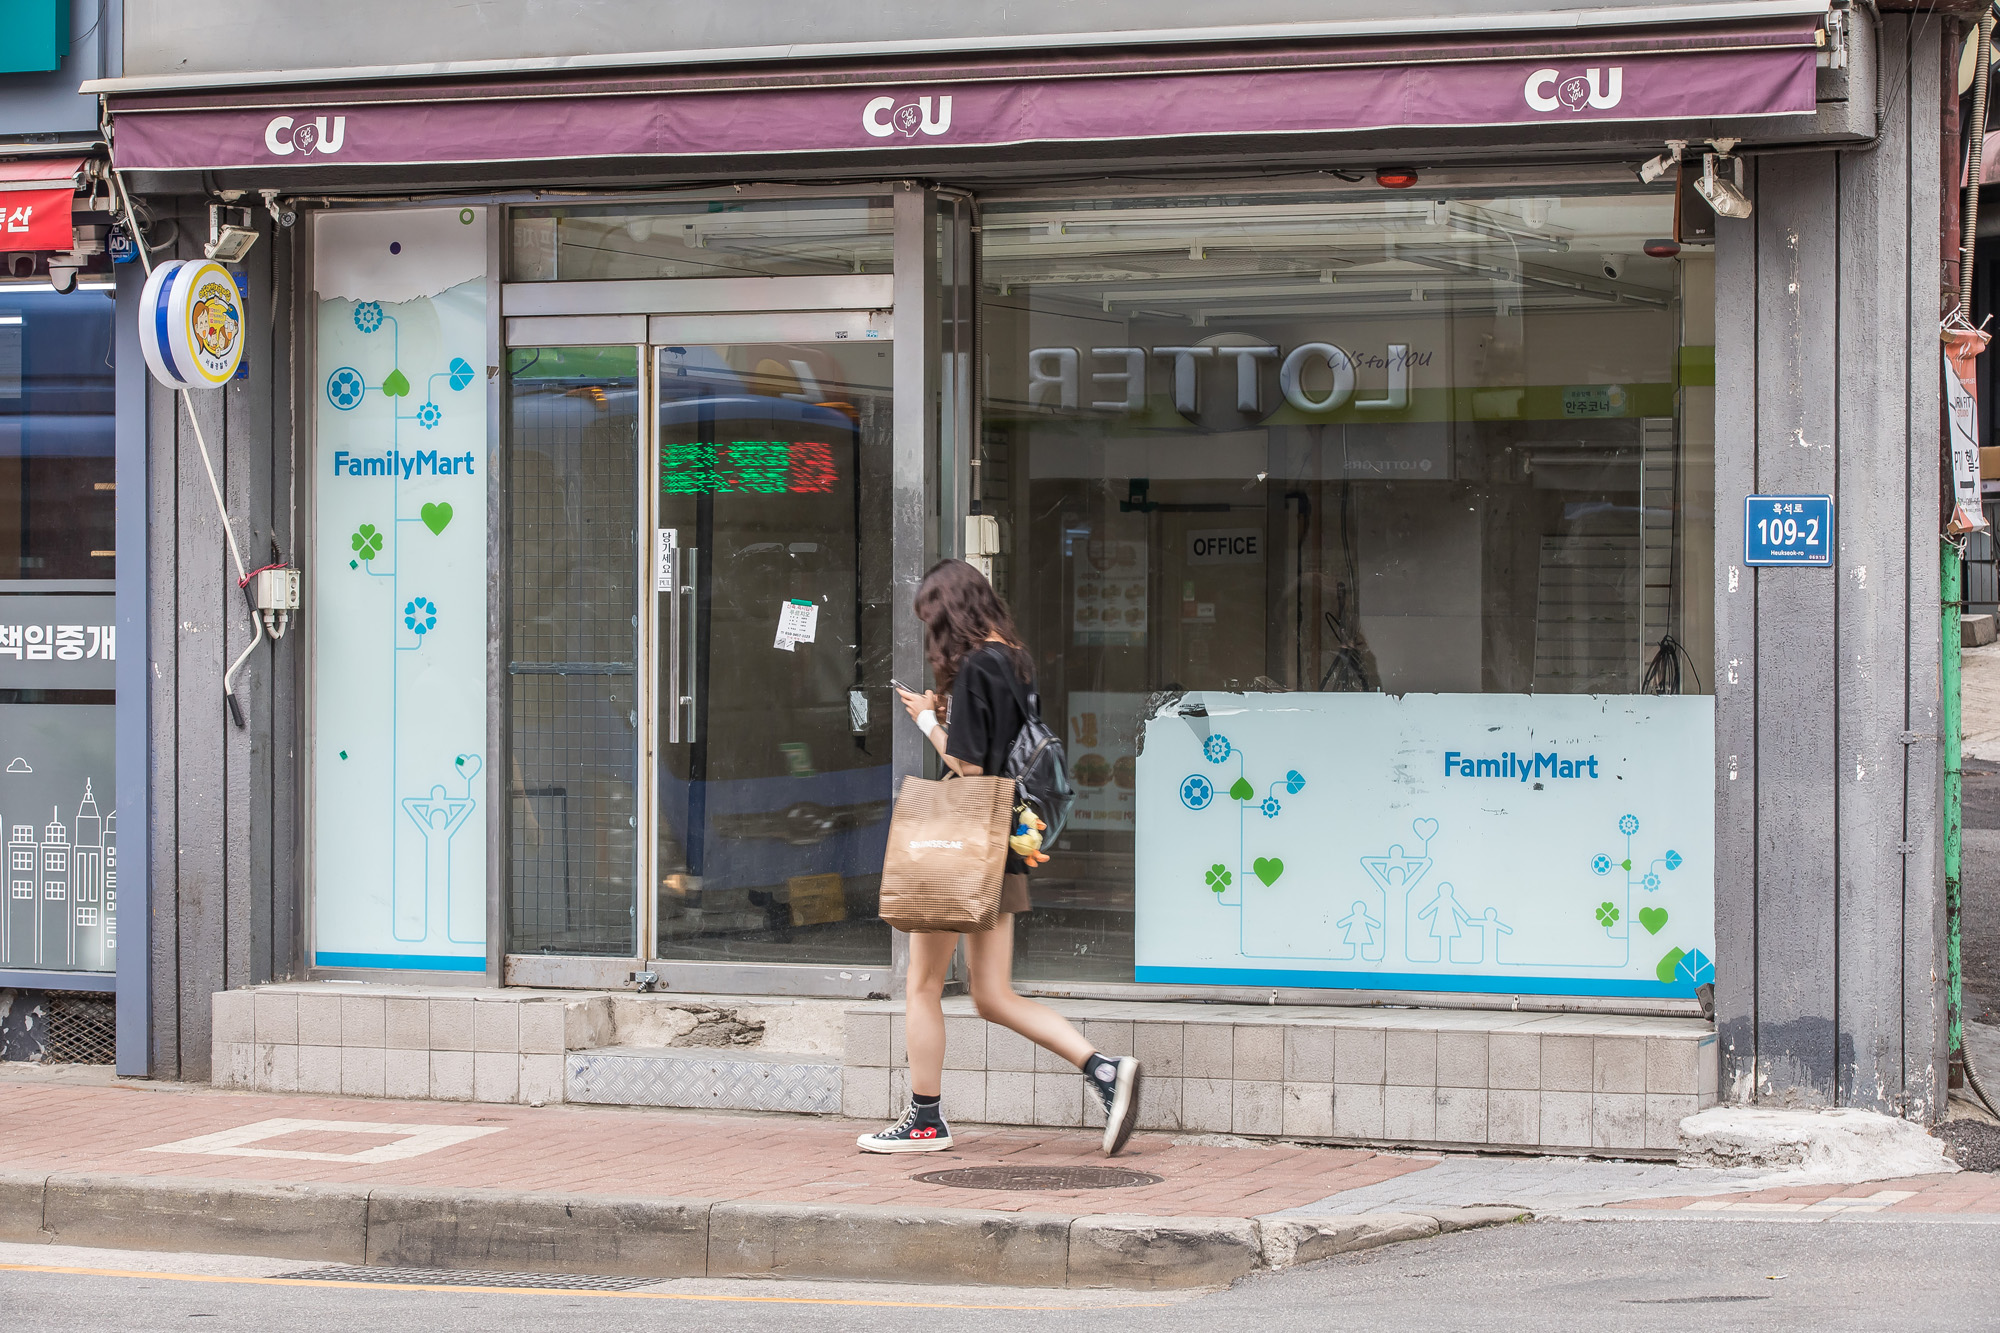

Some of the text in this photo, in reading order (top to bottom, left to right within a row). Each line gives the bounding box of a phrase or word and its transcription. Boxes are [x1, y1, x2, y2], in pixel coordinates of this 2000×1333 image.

[1525, 67, 1622, 111] CU
[862, 95, 953, 138] CU
[264, 115, 346, 155] CU
[0, 206, 33, 233] 산
[1565, 400, 1610, 414] 안주코너
[334, 450, 475, 480] FamilyMart
[1772, 503, 1804, 515] 흑석로
[1193, 536, 1257, 556] OFFICE
[1757, 517, 1820, 546] 109-2
[661, 531, 672, 574] 당기세요
[0, 624, 116, 661] 책임중개
[1444, 751, 1599, 782] FamilyMart
